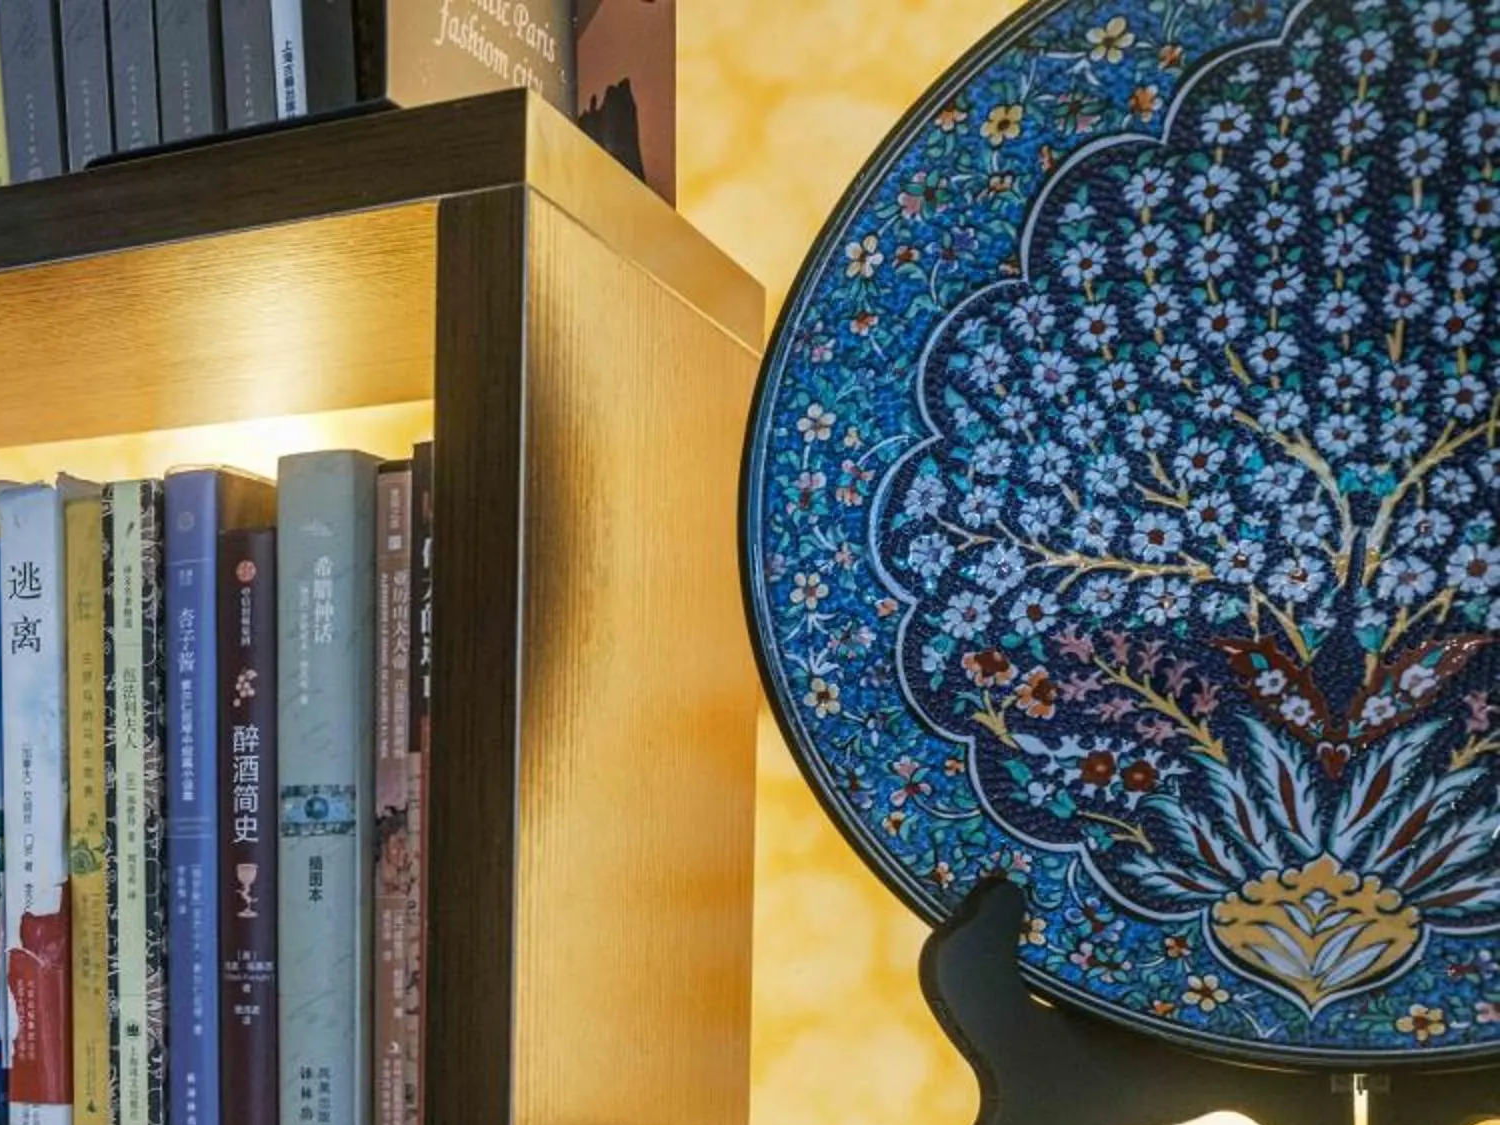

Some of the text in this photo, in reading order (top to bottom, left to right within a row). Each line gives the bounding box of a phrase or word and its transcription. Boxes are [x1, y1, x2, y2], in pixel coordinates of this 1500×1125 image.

[513, 3, 556, 63] Paris
[8, 561, 43, 655] 逃离
[313, 556, 334, 643] 希腊神话
[122, 667, 139, 749] 包法利夫人
[233, 724, 260, 843] 醉酒简史
